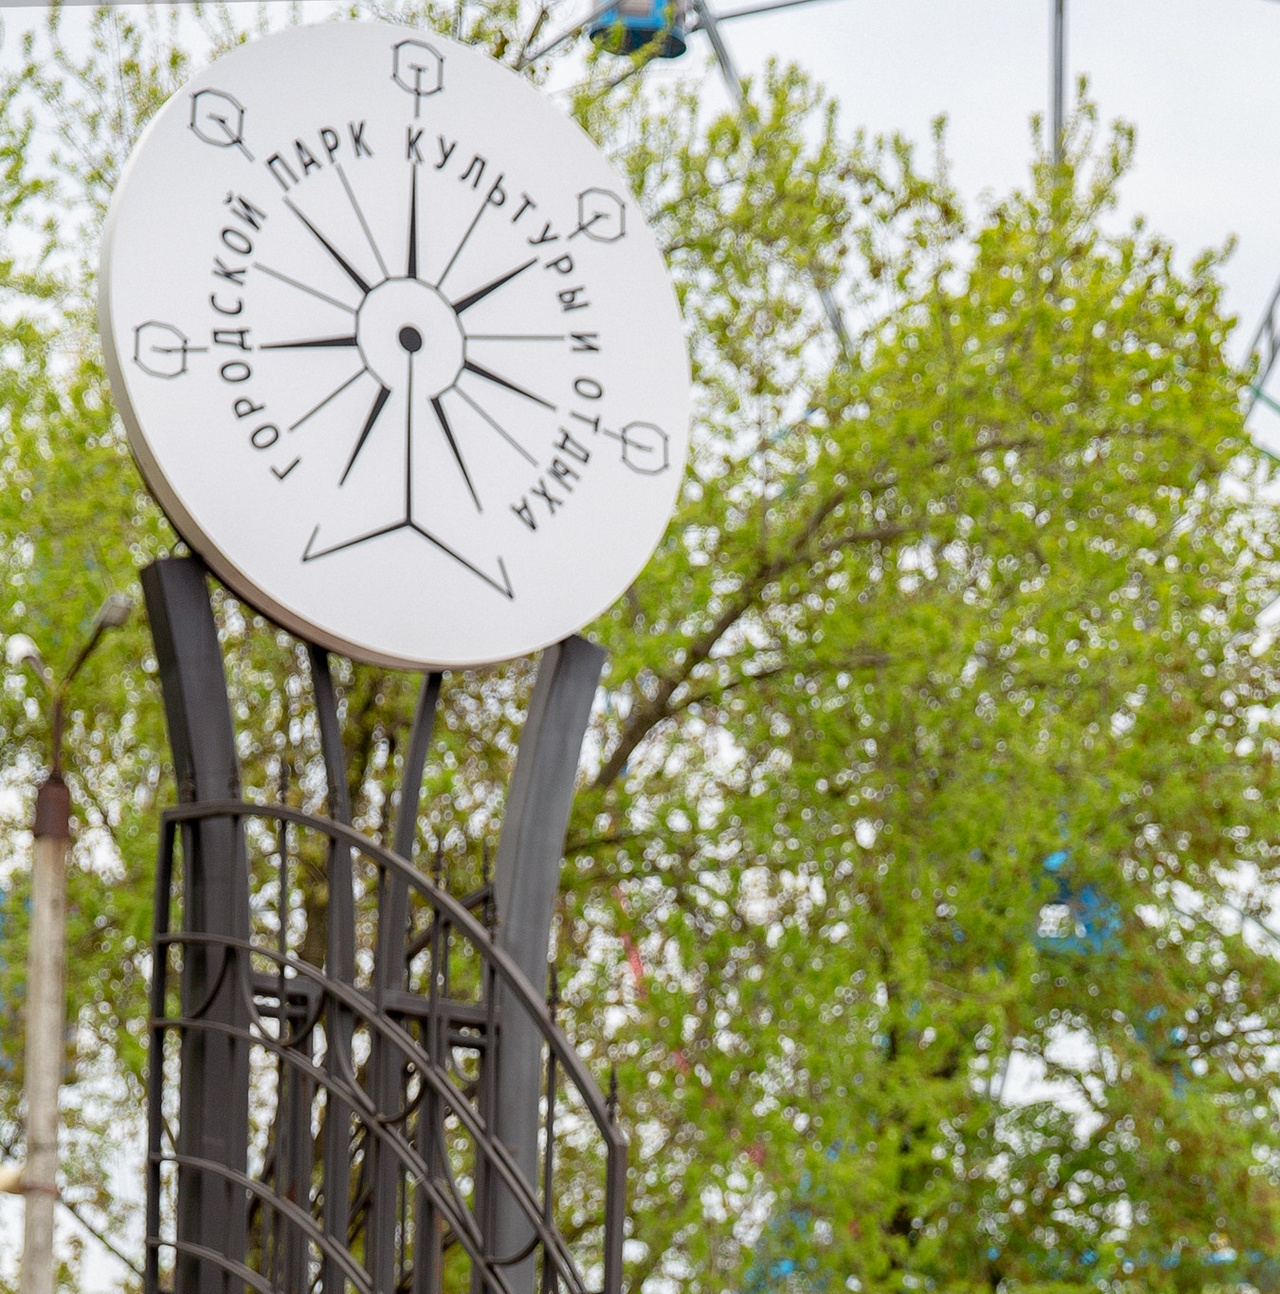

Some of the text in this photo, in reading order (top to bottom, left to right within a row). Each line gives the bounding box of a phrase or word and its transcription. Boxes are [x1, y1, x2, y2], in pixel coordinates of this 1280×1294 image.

[210, 121, 603, 531] ГОРОДСКОЙ ПАРК КУЛЬТУРЫ И ОТДЫХА
